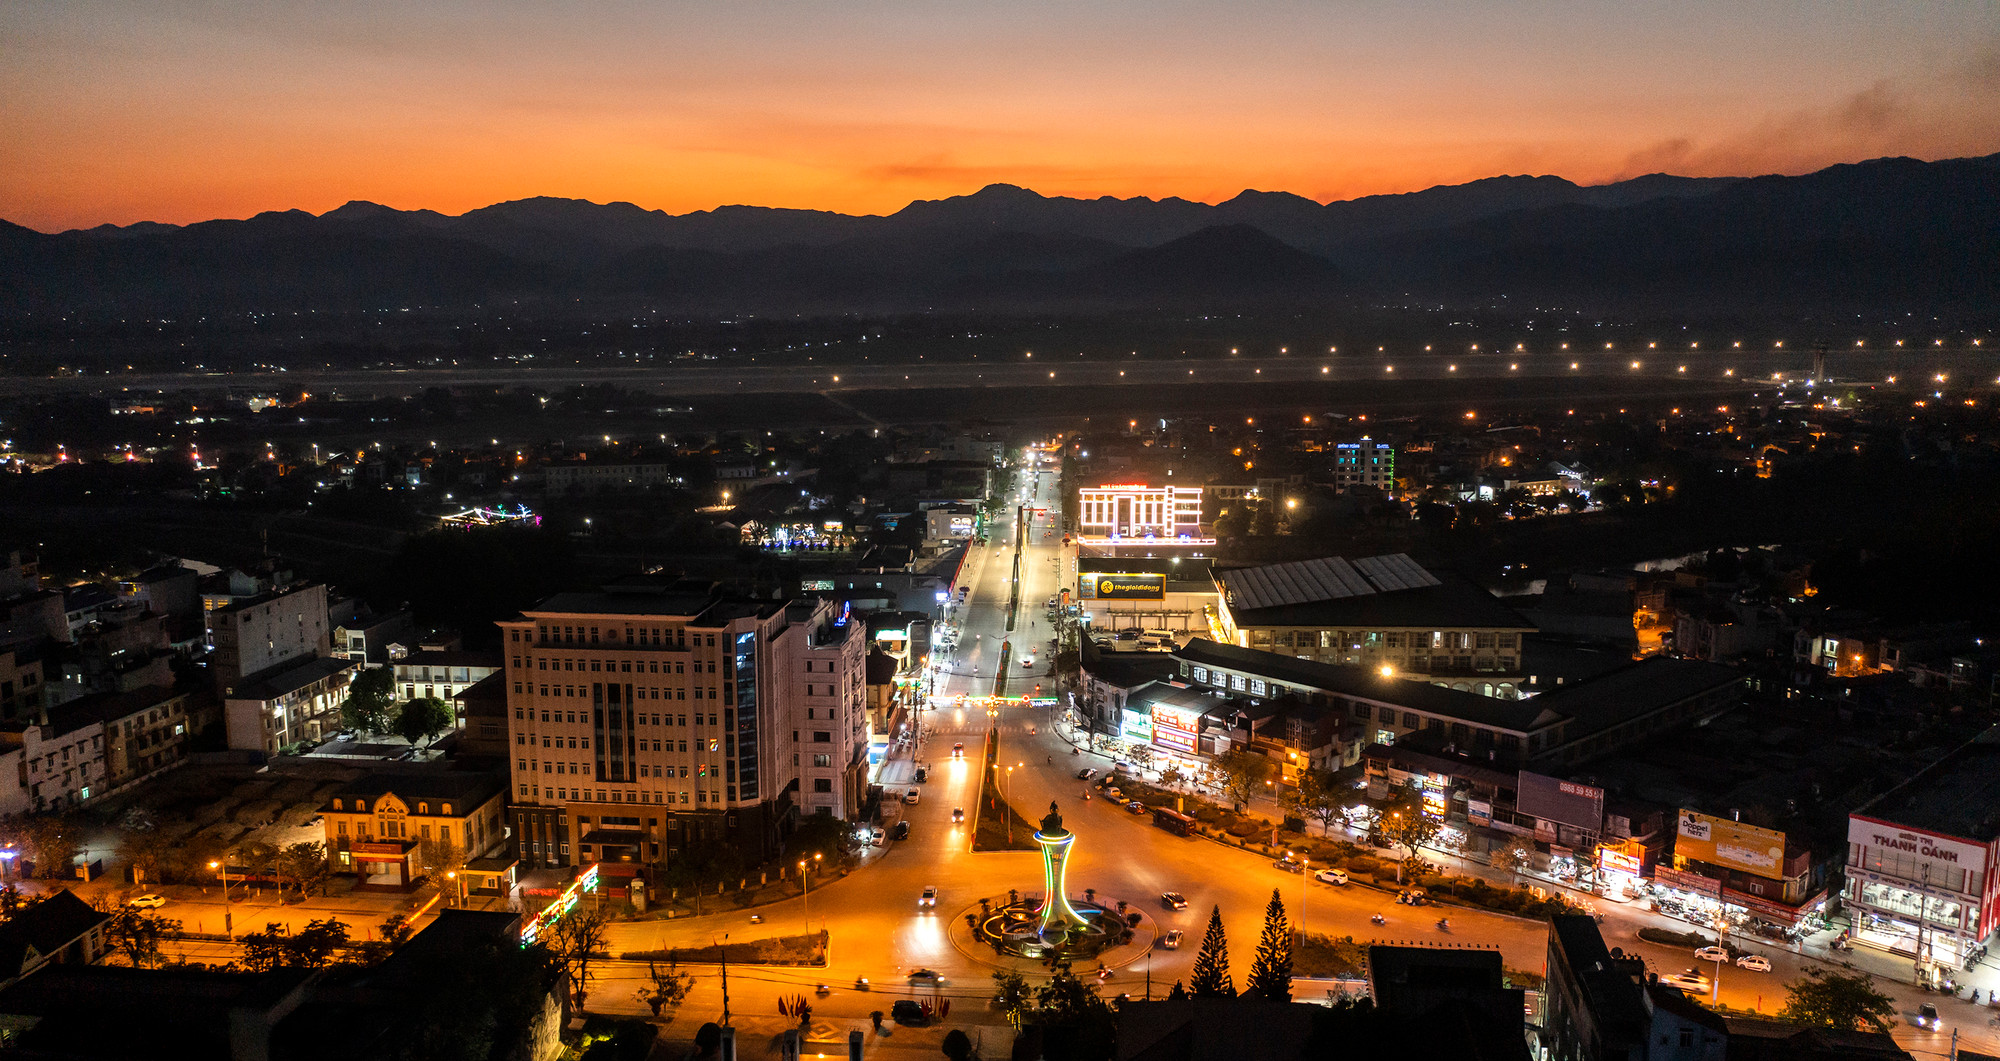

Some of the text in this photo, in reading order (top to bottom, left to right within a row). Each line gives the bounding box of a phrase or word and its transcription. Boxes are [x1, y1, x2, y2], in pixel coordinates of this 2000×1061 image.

[1682, 820, 1708, 832] Doppel
[1687, 827, 1703, 837] herz
[1873, 834, 1958, 862] THANH OÁNH
[1873, 909, 1894, 917] SONY
